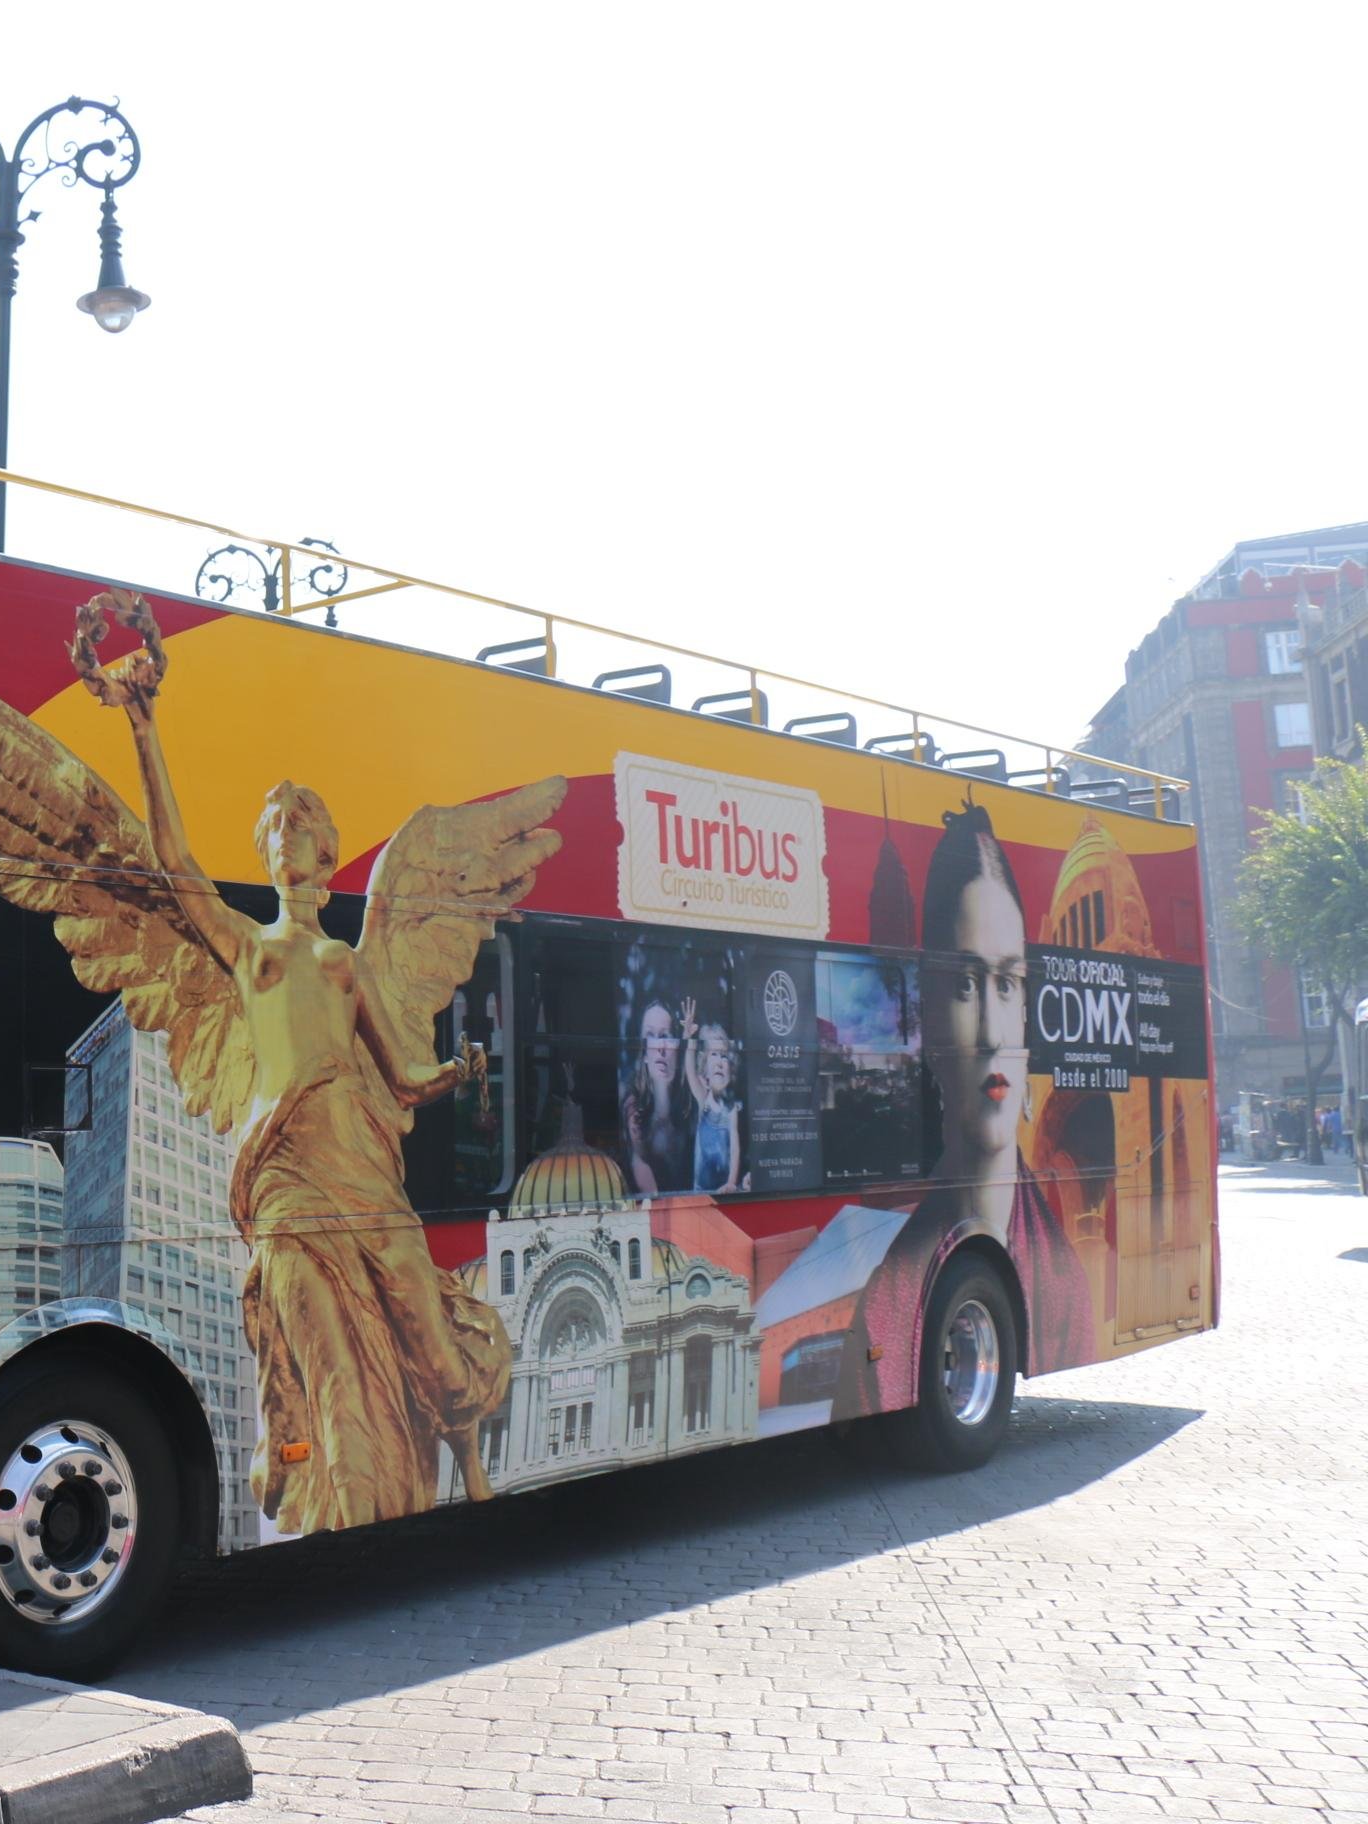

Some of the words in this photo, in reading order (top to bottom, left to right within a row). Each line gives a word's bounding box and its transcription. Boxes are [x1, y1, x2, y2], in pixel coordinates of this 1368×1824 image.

[645, 789, 799, 883] Turibus
[660, 868, 725, 902] Circuito
[1042, 955, 1078, 983] TOUR
[1079, 959, 1128, 988] OFICIAL
[1037, 984, 1134, 1046] CDMX
[767, 1044, 801, 1058] OASIS
[1054, 1066, 1086, 1088] Desde
[1090, 1068, 1101, 1088] el
[1104, 1068, 1128, 1088] 2000
